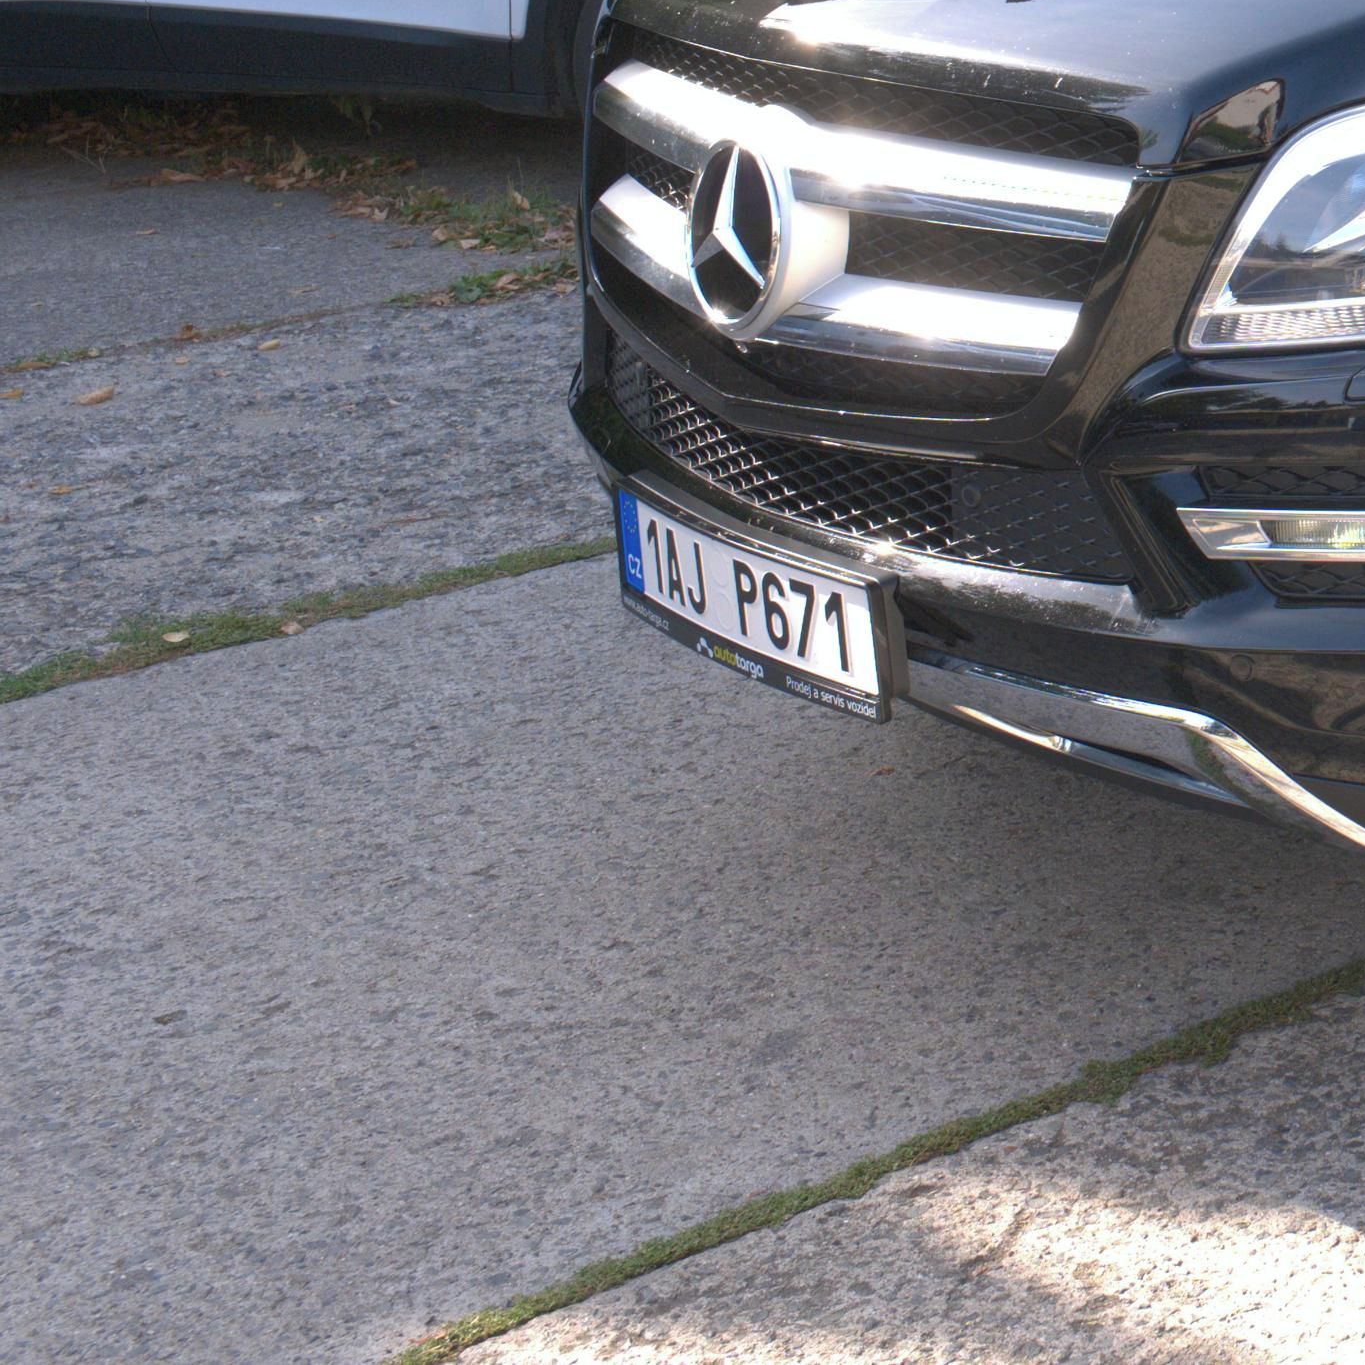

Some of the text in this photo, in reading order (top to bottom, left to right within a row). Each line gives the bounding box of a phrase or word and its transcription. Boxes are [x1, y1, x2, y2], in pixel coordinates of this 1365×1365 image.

[628, 554, 642, 579] CZ
[647, 518, 851, 674] 1AJ P671
[786, 675, 877, 719] Prodej a servis vozidel
